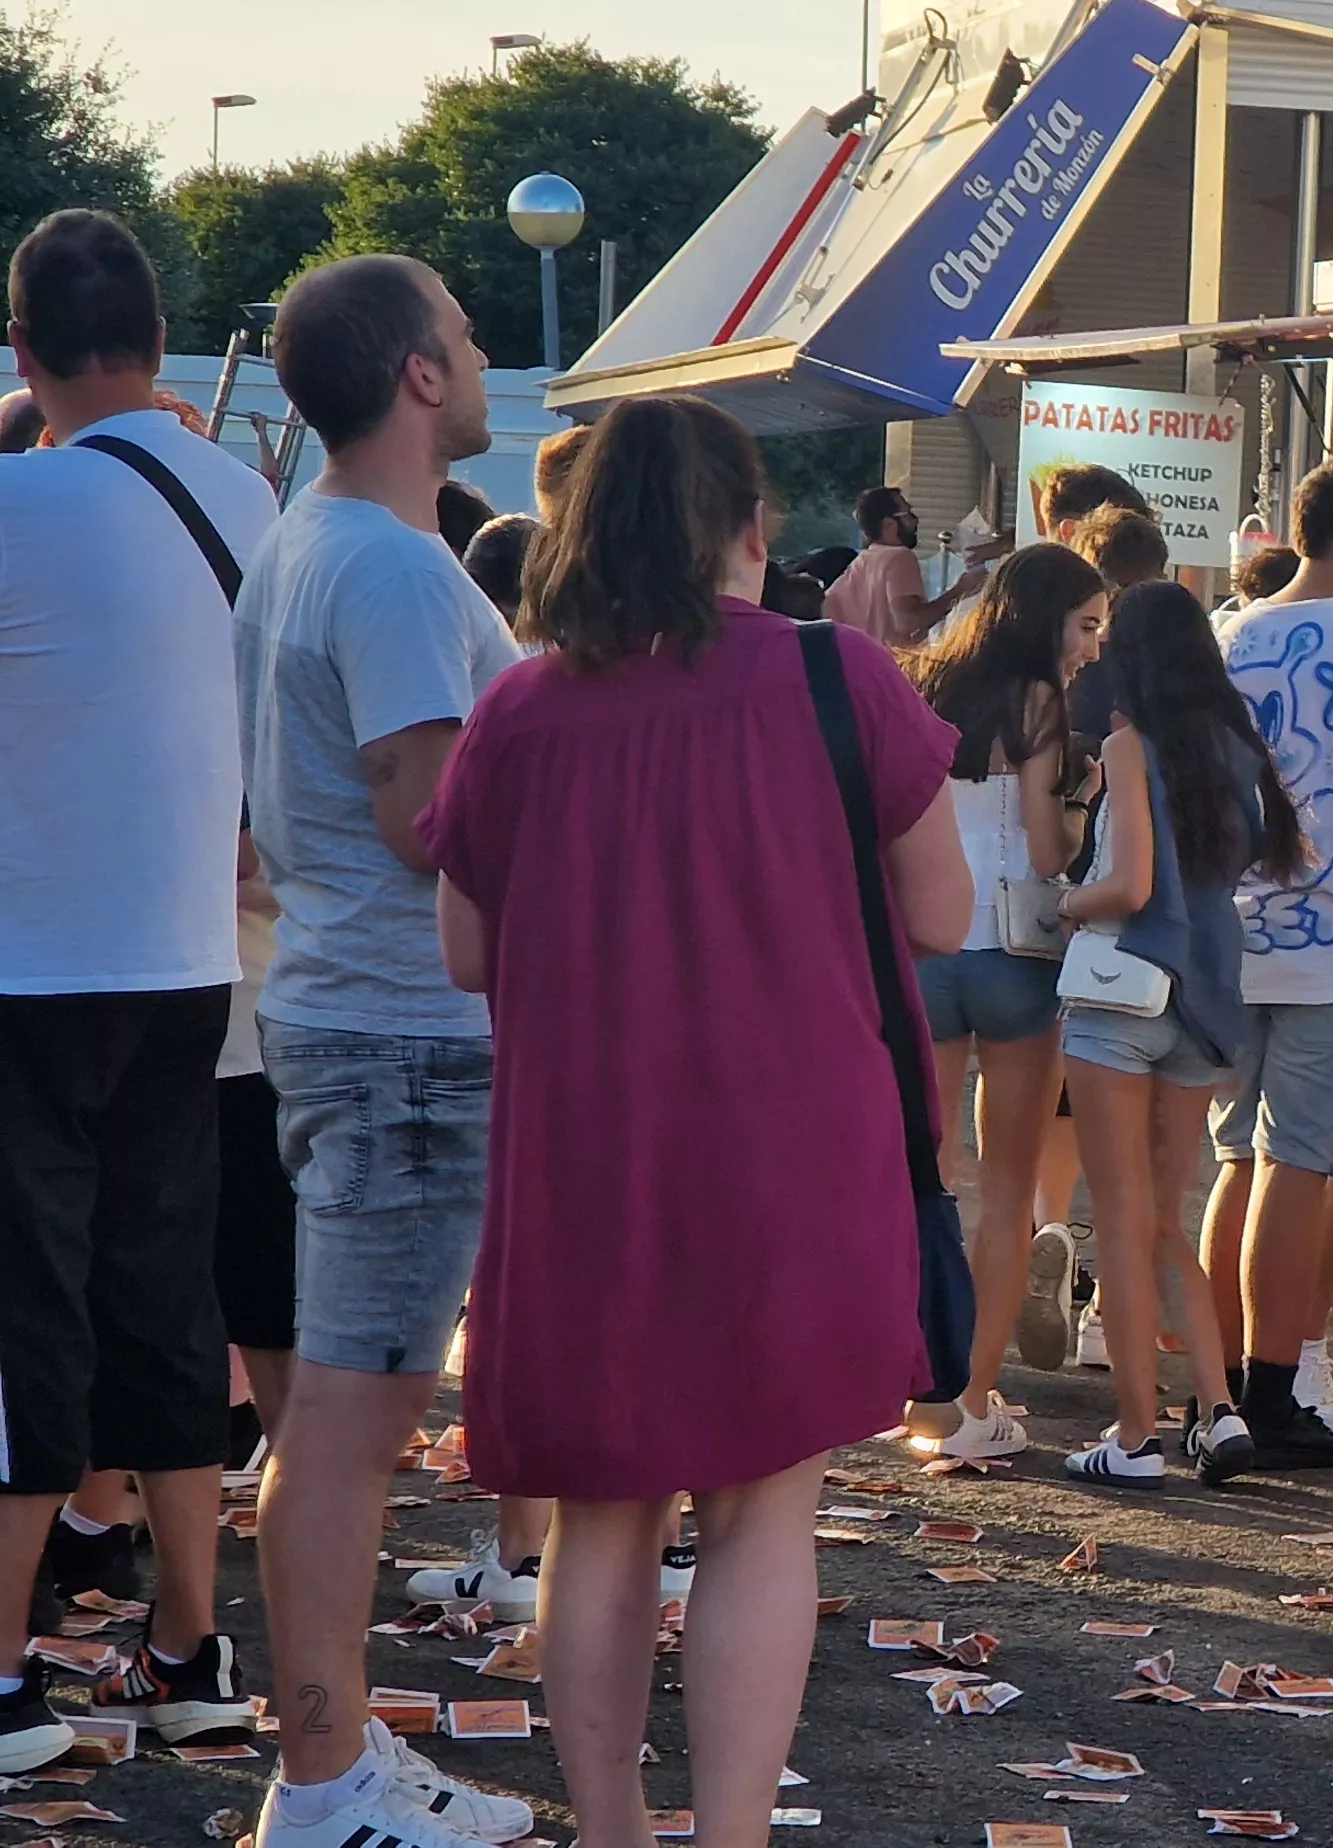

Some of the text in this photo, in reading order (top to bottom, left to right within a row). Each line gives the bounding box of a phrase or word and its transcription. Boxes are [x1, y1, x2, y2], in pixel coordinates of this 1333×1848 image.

[963, 173, 996, 202] La
[1040, 129, 1105, 221] de Monzón
[929, 98, 1084, 310] Churrería
[1023, 400, 1235, 443] PATATAS FRITAS
[1128, 462, 1213, 484] KETCHUP
[1144, 493, 1220, 512] HONESA
[1162, 521, 1210, 540] TAZA
[299, 1684, 332, 1734] 2
